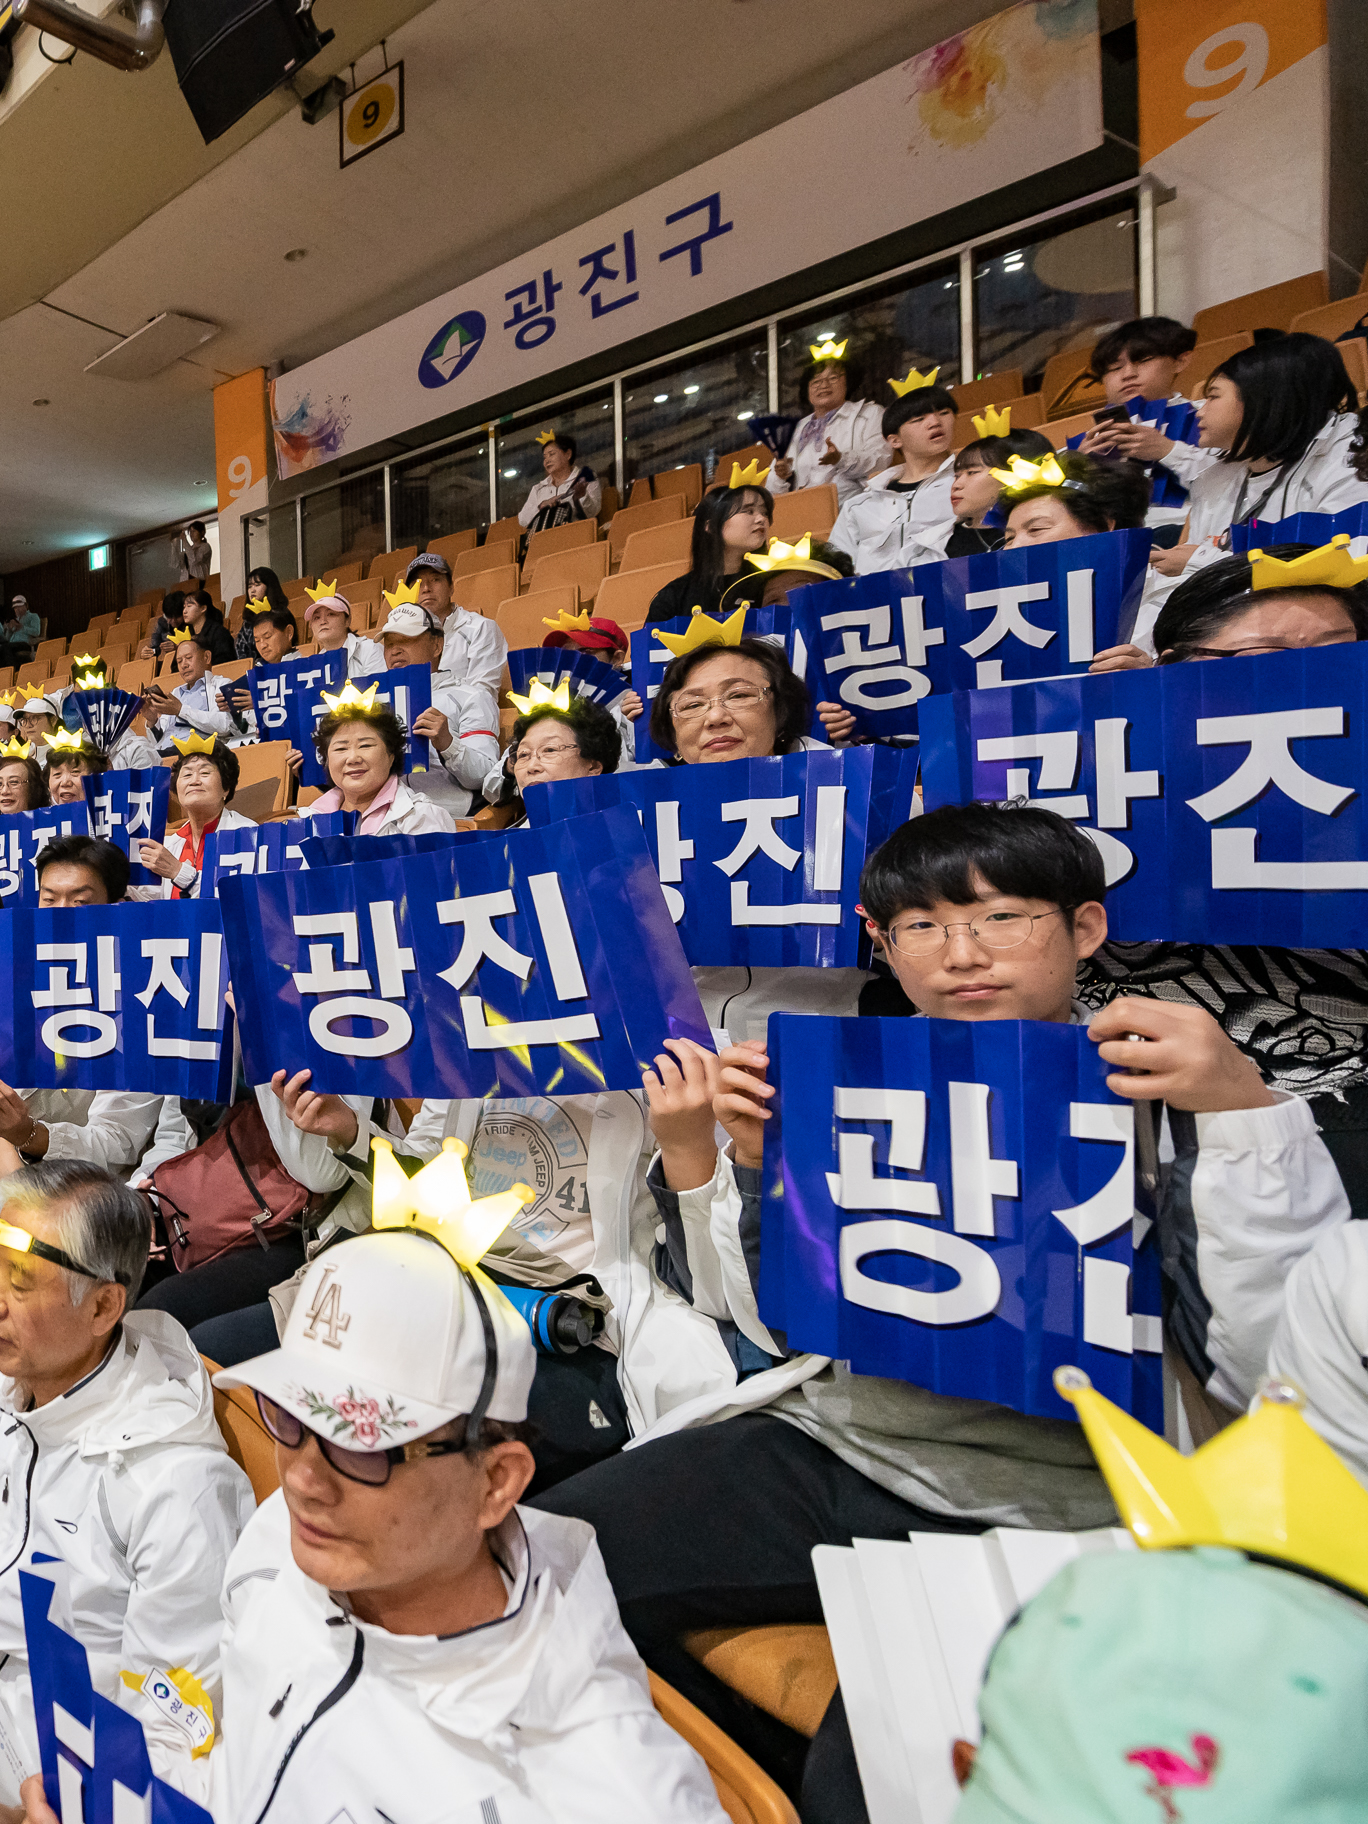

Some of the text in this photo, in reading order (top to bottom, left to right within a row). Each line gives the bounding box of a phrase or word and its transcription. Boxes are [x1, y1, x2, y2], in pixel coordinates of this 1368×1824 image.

[1184, 21, 1270, 119] 9
[362, 100, 381, 131] 9
[503, 191, 733, 351] 광진구
[228, 455, 252, 498] 9
[820, 568, 1094, 711] 광진
[31, 932, 223, 1061] 광진
[291, 871, 601, 1058] 광진
[479, 1140, 527, 1171] Jeep
[491, 1125, 516, 1136] RIDE
[533, 1158, 546, 1188] JEEP
[303, 1263, 351, 1351] LA
